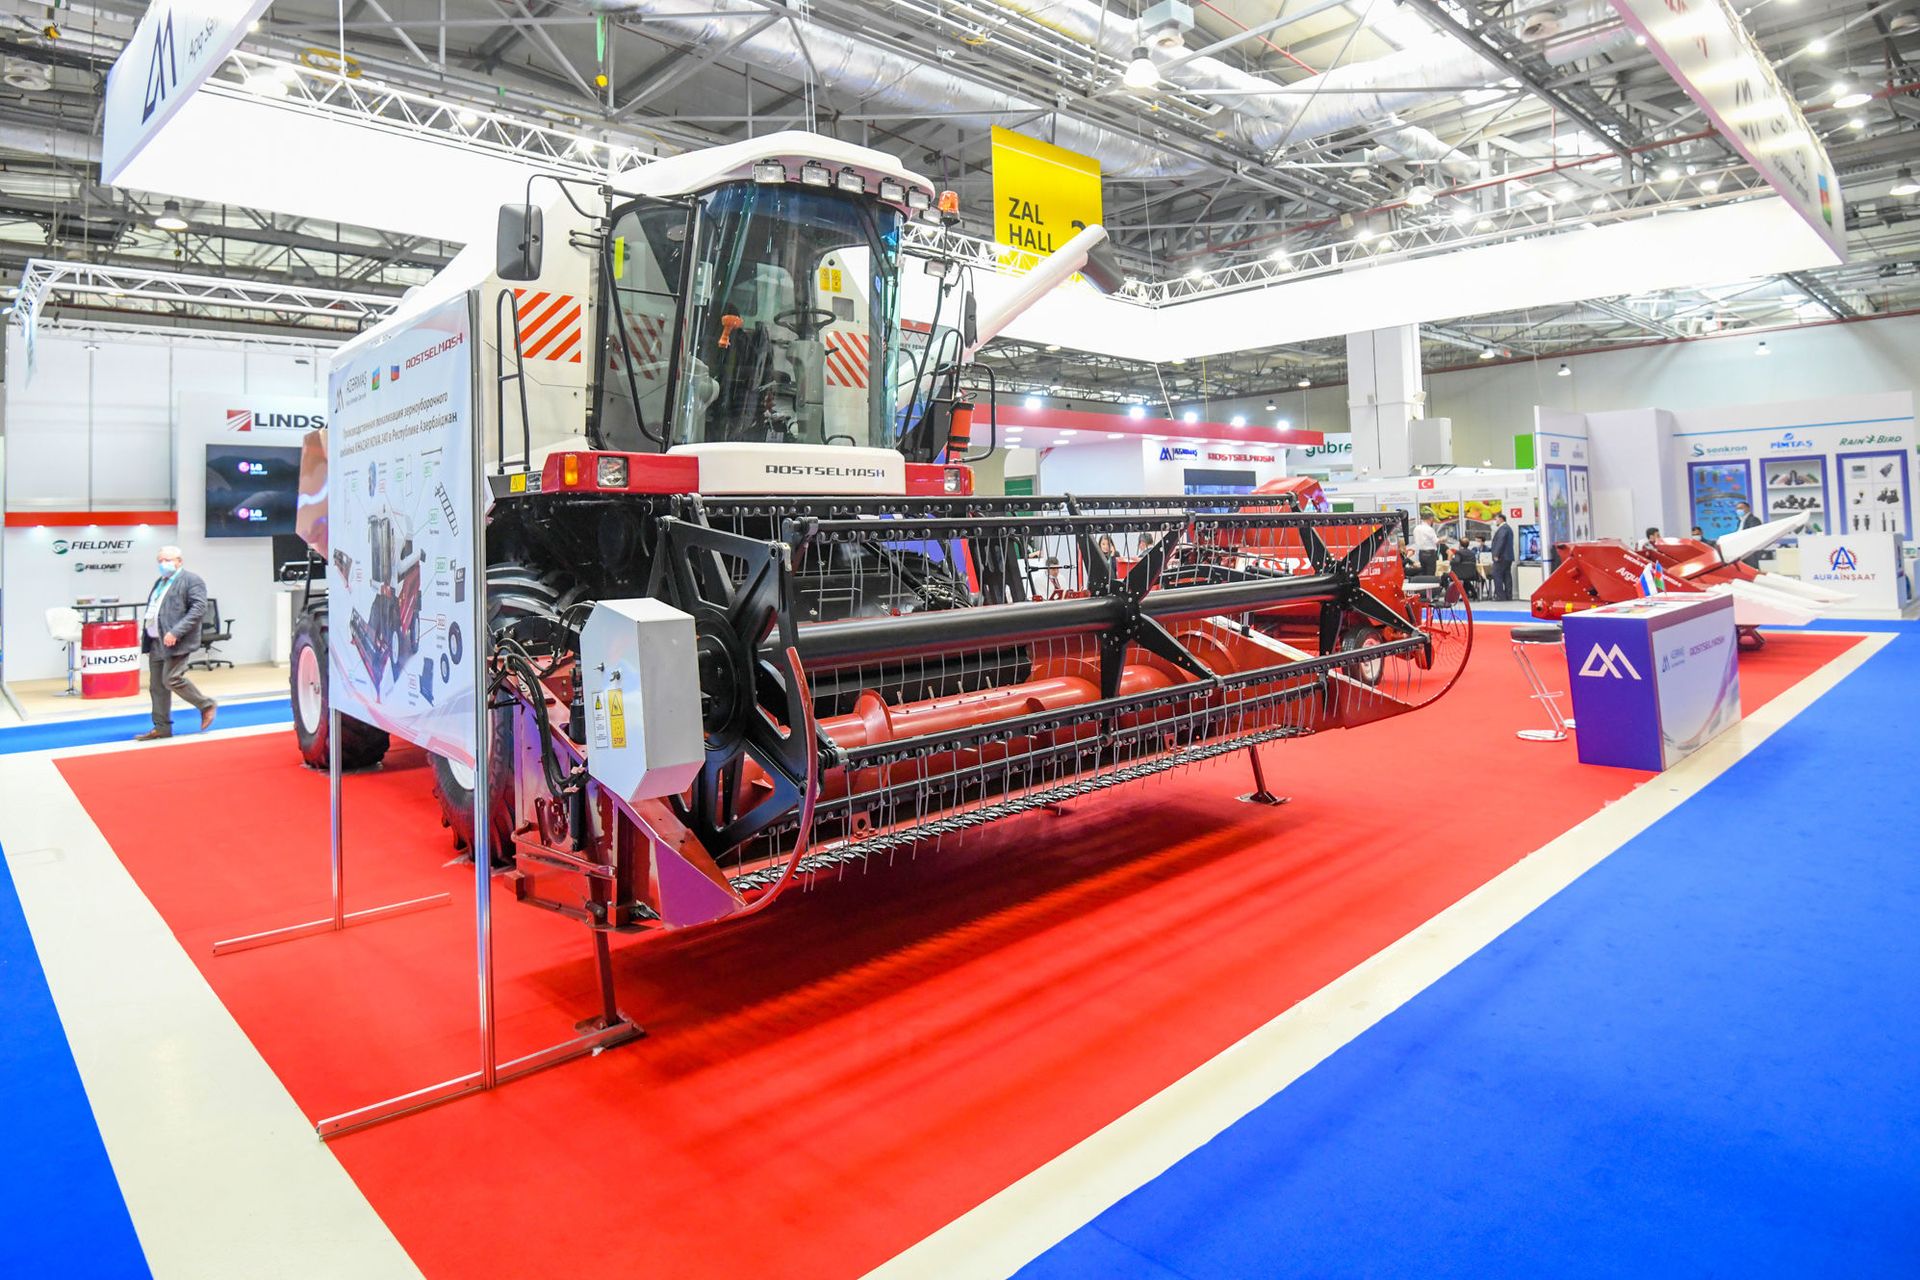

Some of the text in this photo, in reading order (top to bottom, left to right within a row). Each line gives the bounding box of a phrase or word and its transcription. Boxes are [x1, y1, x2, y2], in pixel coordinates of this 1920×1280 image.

[1009, 197, 1044, 225] ZAL
[1009, 223, 1056, 253] HALL
[406, 333, 463, 370] ROSTSELMASH
[254, 413, 327, 429] LINDS
[420, 412, 457, 434] Азербайджан
[1839, 434, 1902, 446] RAIN BIRD
[765, 464, 885, 477] ROSTSELMASH
[71, 540, 134, 550] FIELDNET
[1616, 567, 1641, 583] Argu
[87, 654, 138, 665] LINDSAY
